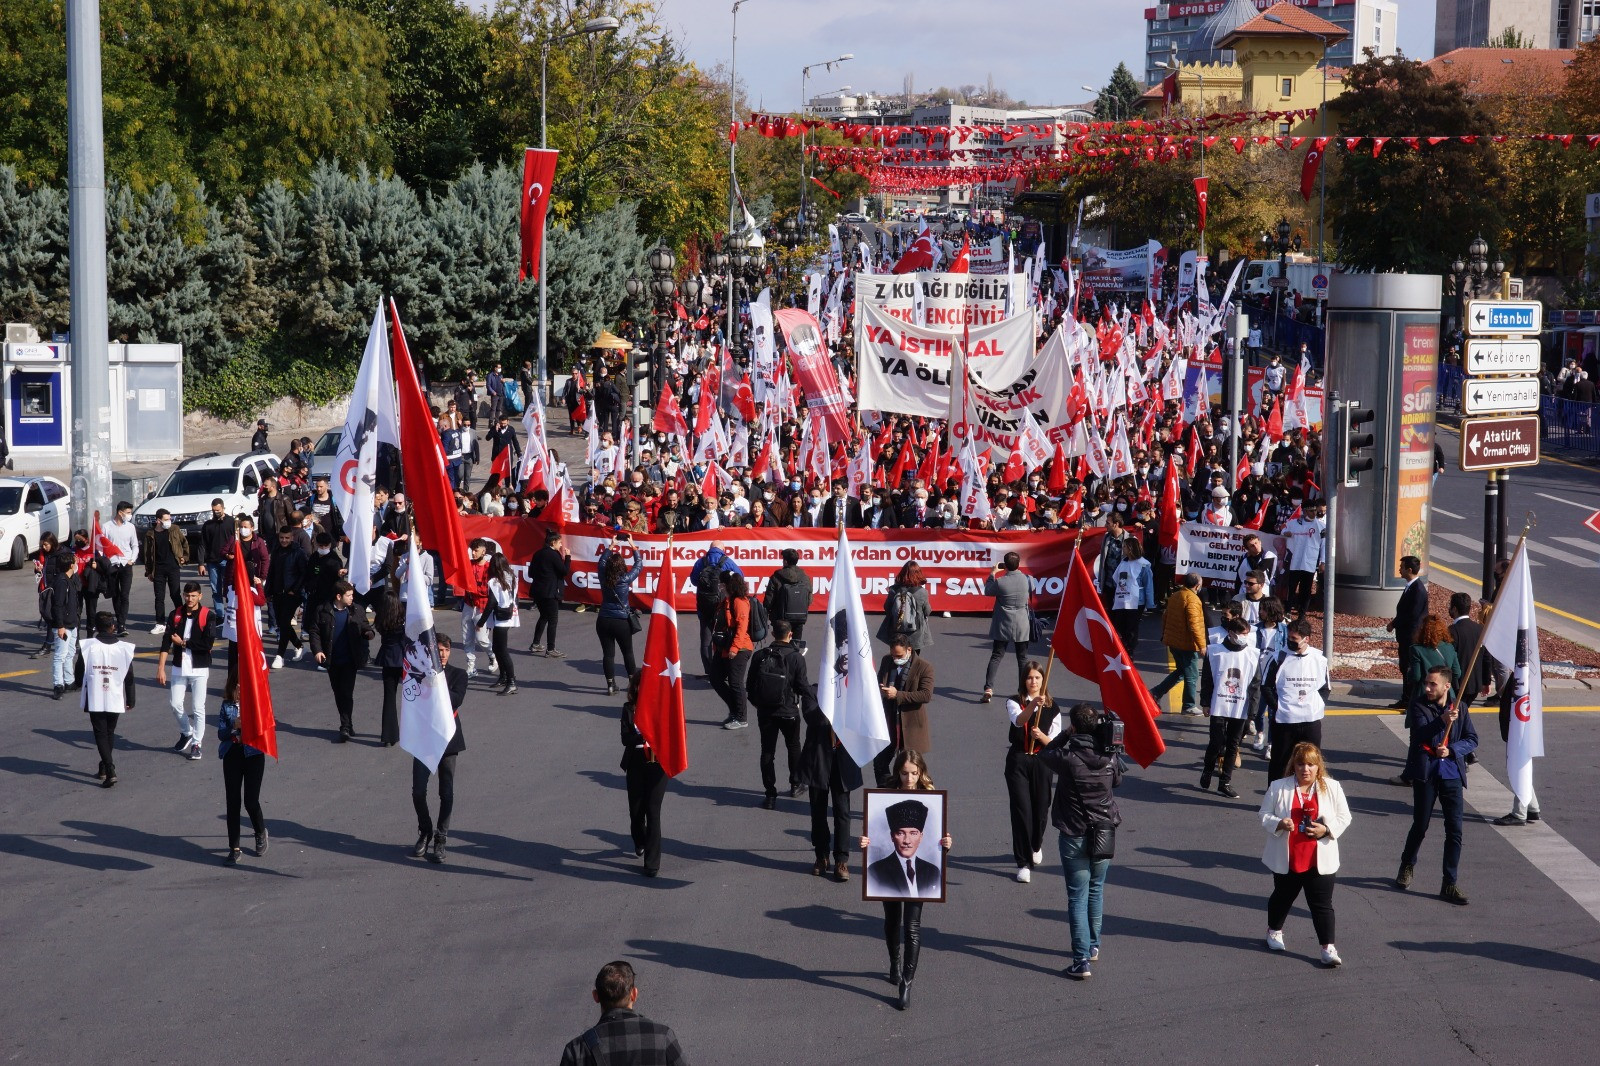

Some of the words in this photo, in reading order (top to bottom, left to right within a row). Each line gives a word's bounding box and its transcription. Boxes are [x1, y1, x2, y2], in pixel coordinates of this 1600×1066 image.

[1179, 4, 1205, 15] SPOR
[875, 284, 886, 299] Z
[893, 278, 948, 299] KUAĞI
[1490, 308, 1533, 325] İstanbul
[866, 324, 895, 346] YA
[1488, 352, 1530, 364] Keçiören
[878, 356, 909, 376] YA
[1487, 390, 1538, 404] Yenimahalle
[1484, 428, 1522, 443] Atatürk
[1484, 444, 1508, 457] Orman
[1509, 444, 1530, 456] Çiftliği
[896, 547, 991, 564] Okuyoruz!
[1180, 560, 1227, 572] UYKULARI
[1210, 580, 1235, 590] AYDIN
